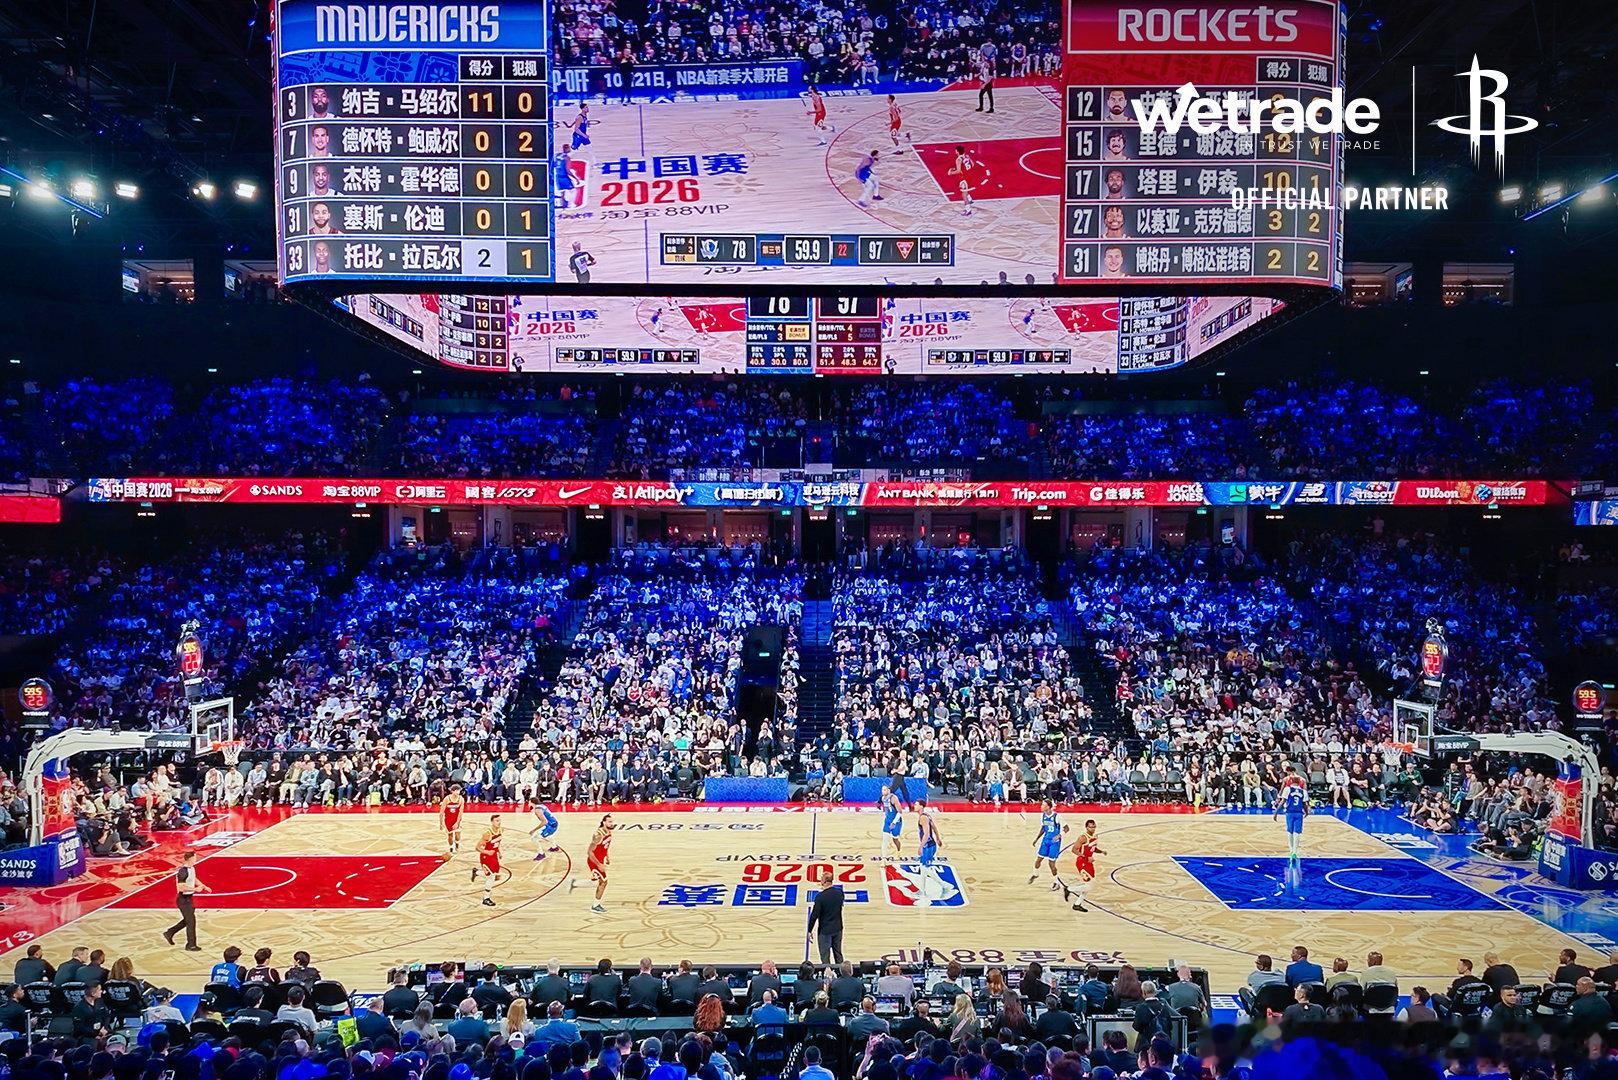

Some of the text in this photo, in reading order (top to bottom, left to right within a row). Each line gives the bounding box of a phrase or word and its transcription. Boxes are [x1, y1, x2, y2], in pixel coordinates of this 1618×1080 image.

[316, 5, 500, 43] MAVERICKS
[1118, 6, 1299, 42] ROCKETS
[468, 60, 494, 76] 得分
[512, 60, 538, 77] 犯规
[1266, 61, 1291, 78] 得分
[1308, 64, 1328, 81] 犯规
[288, 91, 297, 117] 3
[342, 88, 458, 115] 纳吉·马绍尔
[468, 92, 493, 112] 11
[518, 92, 532, 113] 0
[1077, 92, 1093, 117] 12
[288, 129, 297, 155] 7
[342, 126, 459, 153] 德怀特·鲍威尔
[475, 131, 489, 151] 0
[518, 131, 533, 152] 2
[1076, 130, 1092, 156] 15
[602, 153, 749, 180] 中国赛
[290, 168, 298, 194] 9
[343, 166, 460, 192] 杰特·霍华德
[475, 170, 490, 191] 0
[519, 170, 534, 191] 0
[1075, 170, 1092, 195] 17
[1138, 169, 1238, 195] 塔里·伊森
[600, 178, 700, 207] 2026
[288, 207, 300, 232] 31
[344, 205, 445, 231] 塞斯·伦迪
[476, 209, 491, 230] 0
[521, 210, 531, 230] 1
[1073, 209, 1092, 234] 27
[1137, 208, 1252, 234] 以赛亚·克劳福德
[1268, 210, 1282, 231] 3
[1308, 213, 1320, 232] 2
[289, 246, 302, 270] 33
[344, 243, 460, 269] 托比·拉瓦尔
[477, 249, 492, 268] 2
[521, 249, 532, 269] 1
[732, 241, 746, 259] 78
[795, 240, 820, 260] 59.9
[838, 244, 847, 256] 22
[869, 241, 882, 260] 97
[1268, 250, 1281, 269] 2
[1074, 248, 1090, 273] 31
[1308, 251, 1319, 271] 2
[477, 302, 488, 311] 12
[496, 303, 500, 311] 1
[1124, 303, 1129, 315] 7
[477, 319, 488, 328] 10
[496, 320, 500, 328] 1
[527, 322, 575, 335] 2026
[900, 323, 948, 337] 2026
[479, 337, 486, 345] 3
[479, 354, 486, 363] 2
[496, 355, 502, 363] 2
[1121, 356, 1129, 367] 33
[112, 482, 172, 498] 中国赛2026
[262, 485, 302, 496] SANDS
[323, 486, 381, 497] 淘宝88VIP
[416, 487, 446, 498] 阿里云
[903, 489, 935, 498] BANK
[1012, 488, 1066, 502] Trip.com
[1104, 488, 1145, 499] 佳得乐
[1167, 484, 1204, 493] JACK&
[1167, 493, 1203, 501] JONES
[1416, 487, 1459, 498] Wilson
[28, 696, 43, 706] 22
[1582, 699, 1597, 708] 22
[0, 859, 37, 870] SANDS
